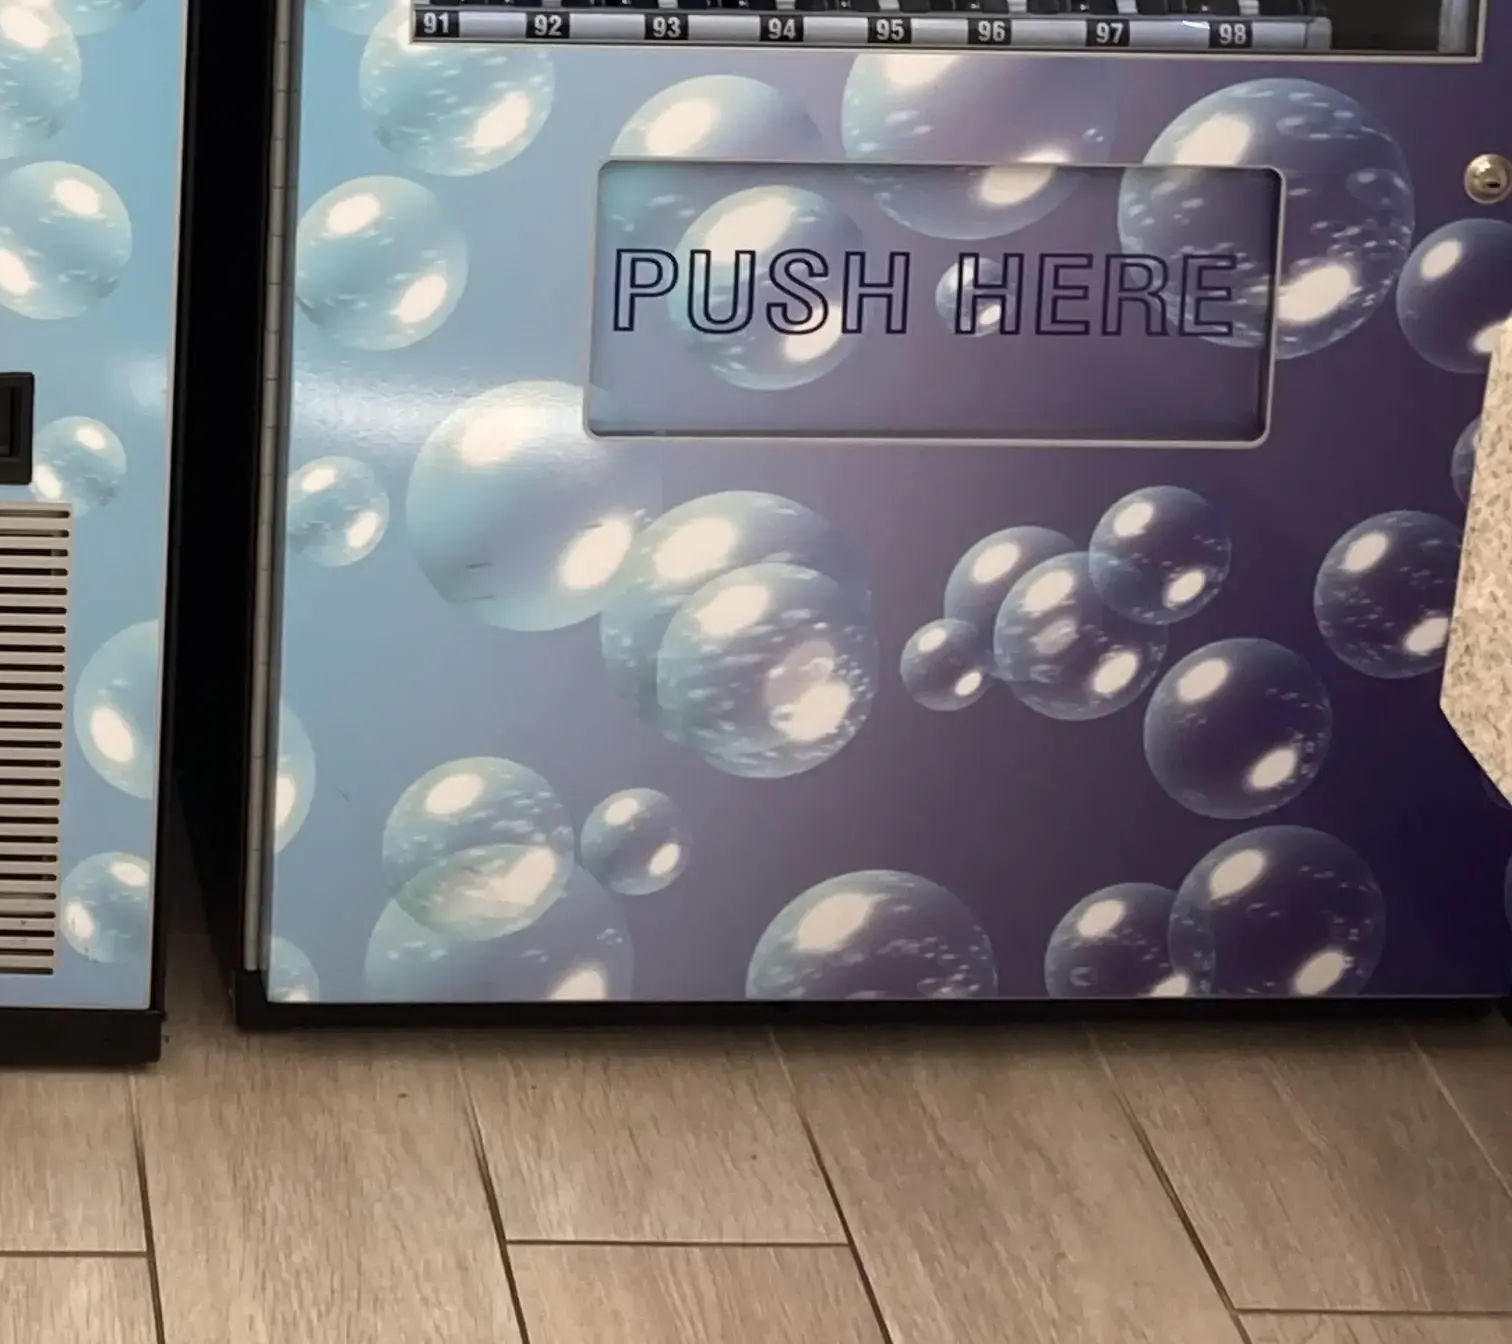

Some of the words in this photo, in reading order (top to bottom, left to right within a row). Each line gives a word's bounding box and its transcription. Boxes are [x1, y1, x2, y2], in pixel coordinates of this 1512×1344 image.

[423, 14, 450, 35] 91
[534, 15, 562, 36] 92
[653, 16, 681, 38] 93
[767, 18, 796, 39] 94
[875, 19, 904, 40] 95
[977, 20, 1005, 42] 96
[1095, 22, 1124, 43] 97
[1218, 23, 1247, 45] 98
[613, 247, 911, 335] PUSH
[953, 252, 1240, 338] HERE
